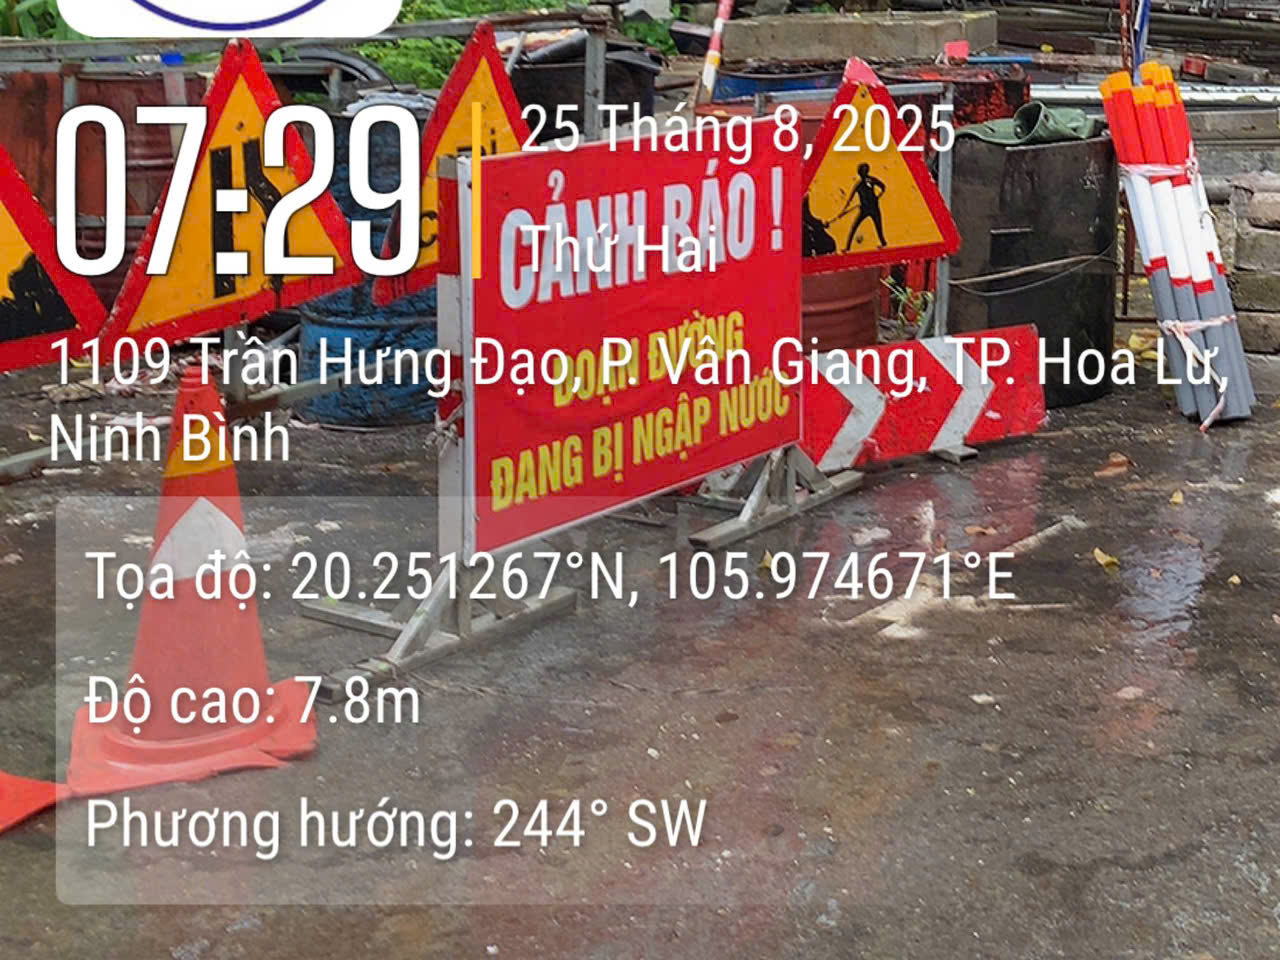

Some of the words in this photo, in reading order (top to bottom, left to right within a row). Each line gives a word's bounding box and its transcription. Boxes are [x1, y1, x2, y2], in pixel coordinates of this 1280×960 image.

[500, 169, 649, 309] CẢNH
[663, 159, 757, 276] BÁO
[490, 434, 583, 512] ĐANG
[592, 422, 624, 482] BỊ
[632, 392, 711, 465] NGẬP
